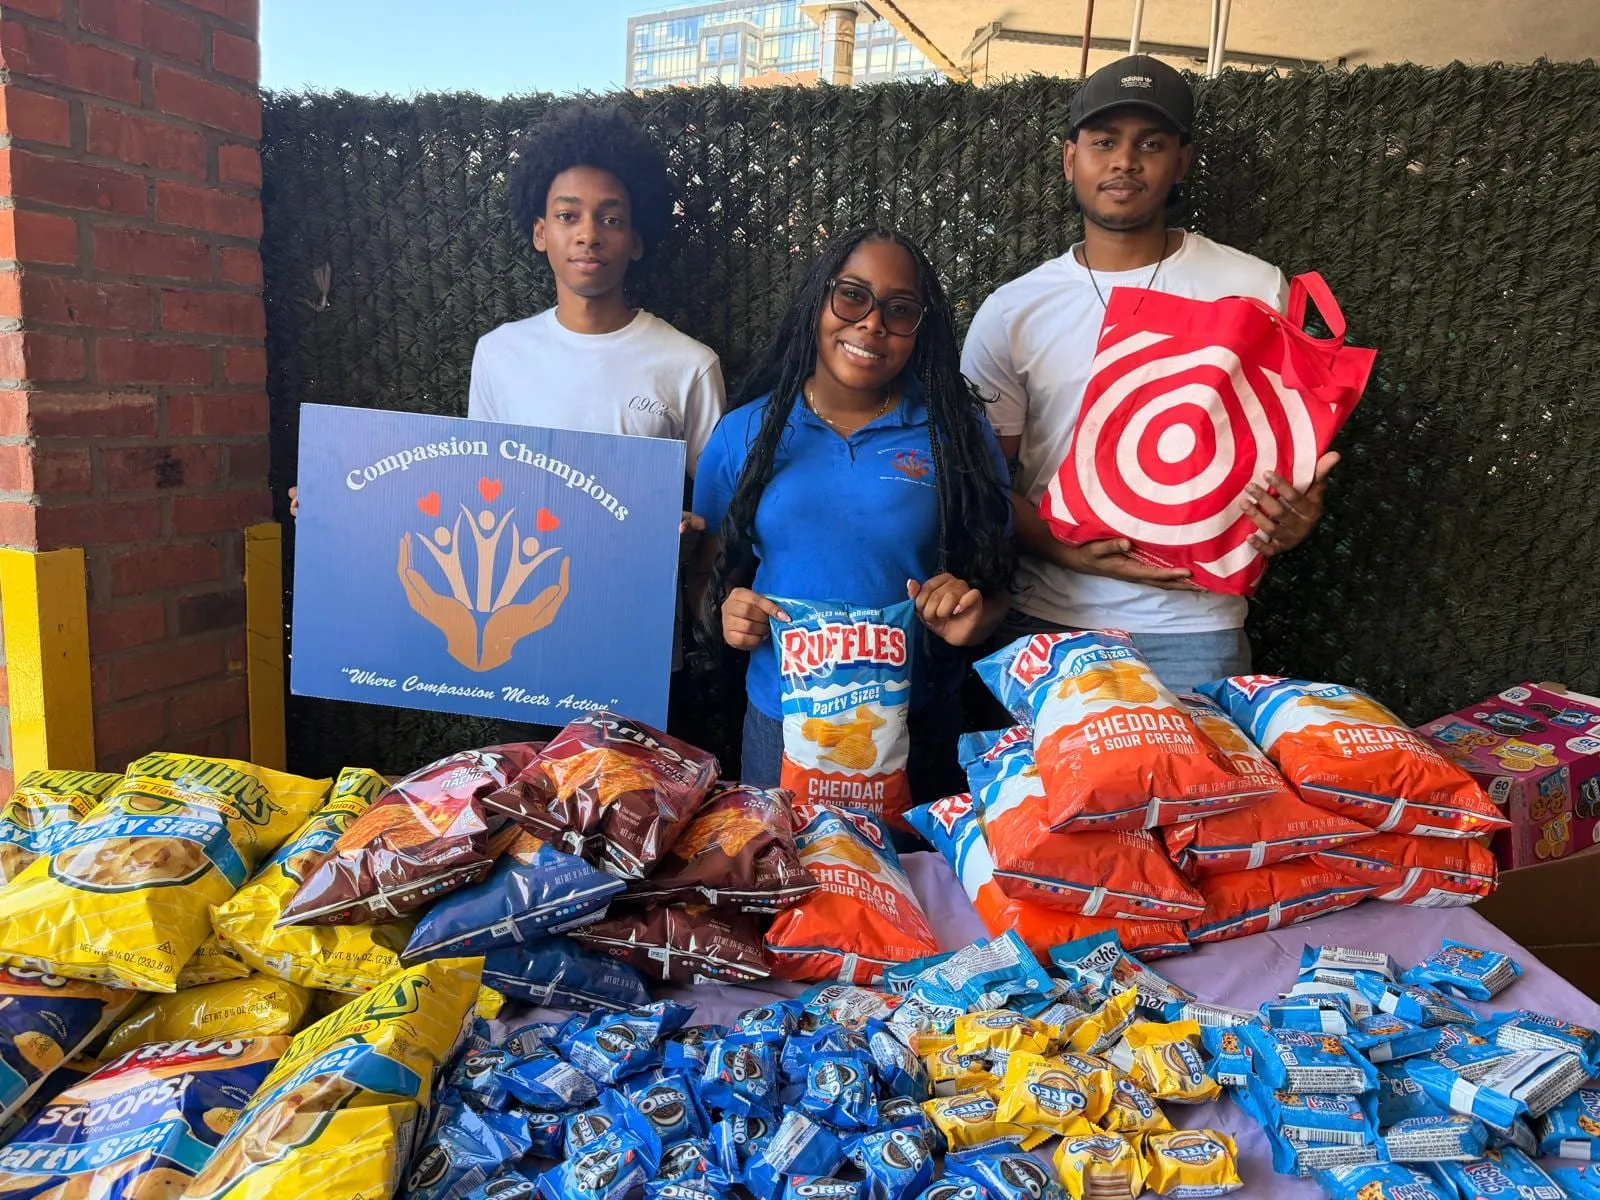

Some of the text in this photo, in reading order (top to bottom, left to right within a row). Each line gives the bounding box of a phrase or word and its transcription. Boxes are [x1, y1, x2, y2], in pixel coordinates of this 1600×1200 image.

[346, 436, 630, 522] Compassion Champions
[782, 622, 907, 675] RUFFLES
[1099, 648, 1133, 660] Size!
[402, 675, 496, 700] Compassion
[501, 686, 551, 707] Meets
[812, 686, 880, 716] Party Size!
[1084, 713, 1190, 742] CHEDDAR
[1090, 731, 1195, 756] & SOUR CREAM
[1358, 743, 1395, 755] SOUR
[1579, 738, 1600, 748] 60
[808, 777, 885, 801] CHEDDAR
[1494, 780, 1509, 791] 60
[324, 801, 356, 812] Onion
[146, 817, 222, 843] Size!
[1117, 836, 1155, 852] FLAVORED
[809, 867, 897, 906] CHEDDAR
[821, 883, 855, 897] SOUR
[79, 943, 92, 953] NET
[138, 955, 164, 971] (233.8
[593, 1029, 637, 1051] OREO
[465, 1056, 506, 1067] OREO
[1061, 1053, 1095, 1074] REO
[1176, 1041, 1202, 1085] OREO
[38, 1074, 196, 1128] SCOOPS!
[638, 1091, 687, 1115] OREO
[1027, 1082, 1088, 1110] OREO
[1039, 1099, 1069, 1114] GOLDEN
[1117, 1079, 1152, 1119] OREO
[943, 1099, 998, 1118] OREO
[81, 1119, 131, 1135] CORN CHIPS
[90, 1122, 176, 1164] Size!
[890, 1130, 923, 1173] OREO
[1161, 1140, 1223, 1157] OREO
[797, 1183, 858, 1196] OREO
[1000, 1155, 1042, 1200] OREO
[1470, 1164, 1504, 1194] Chips
